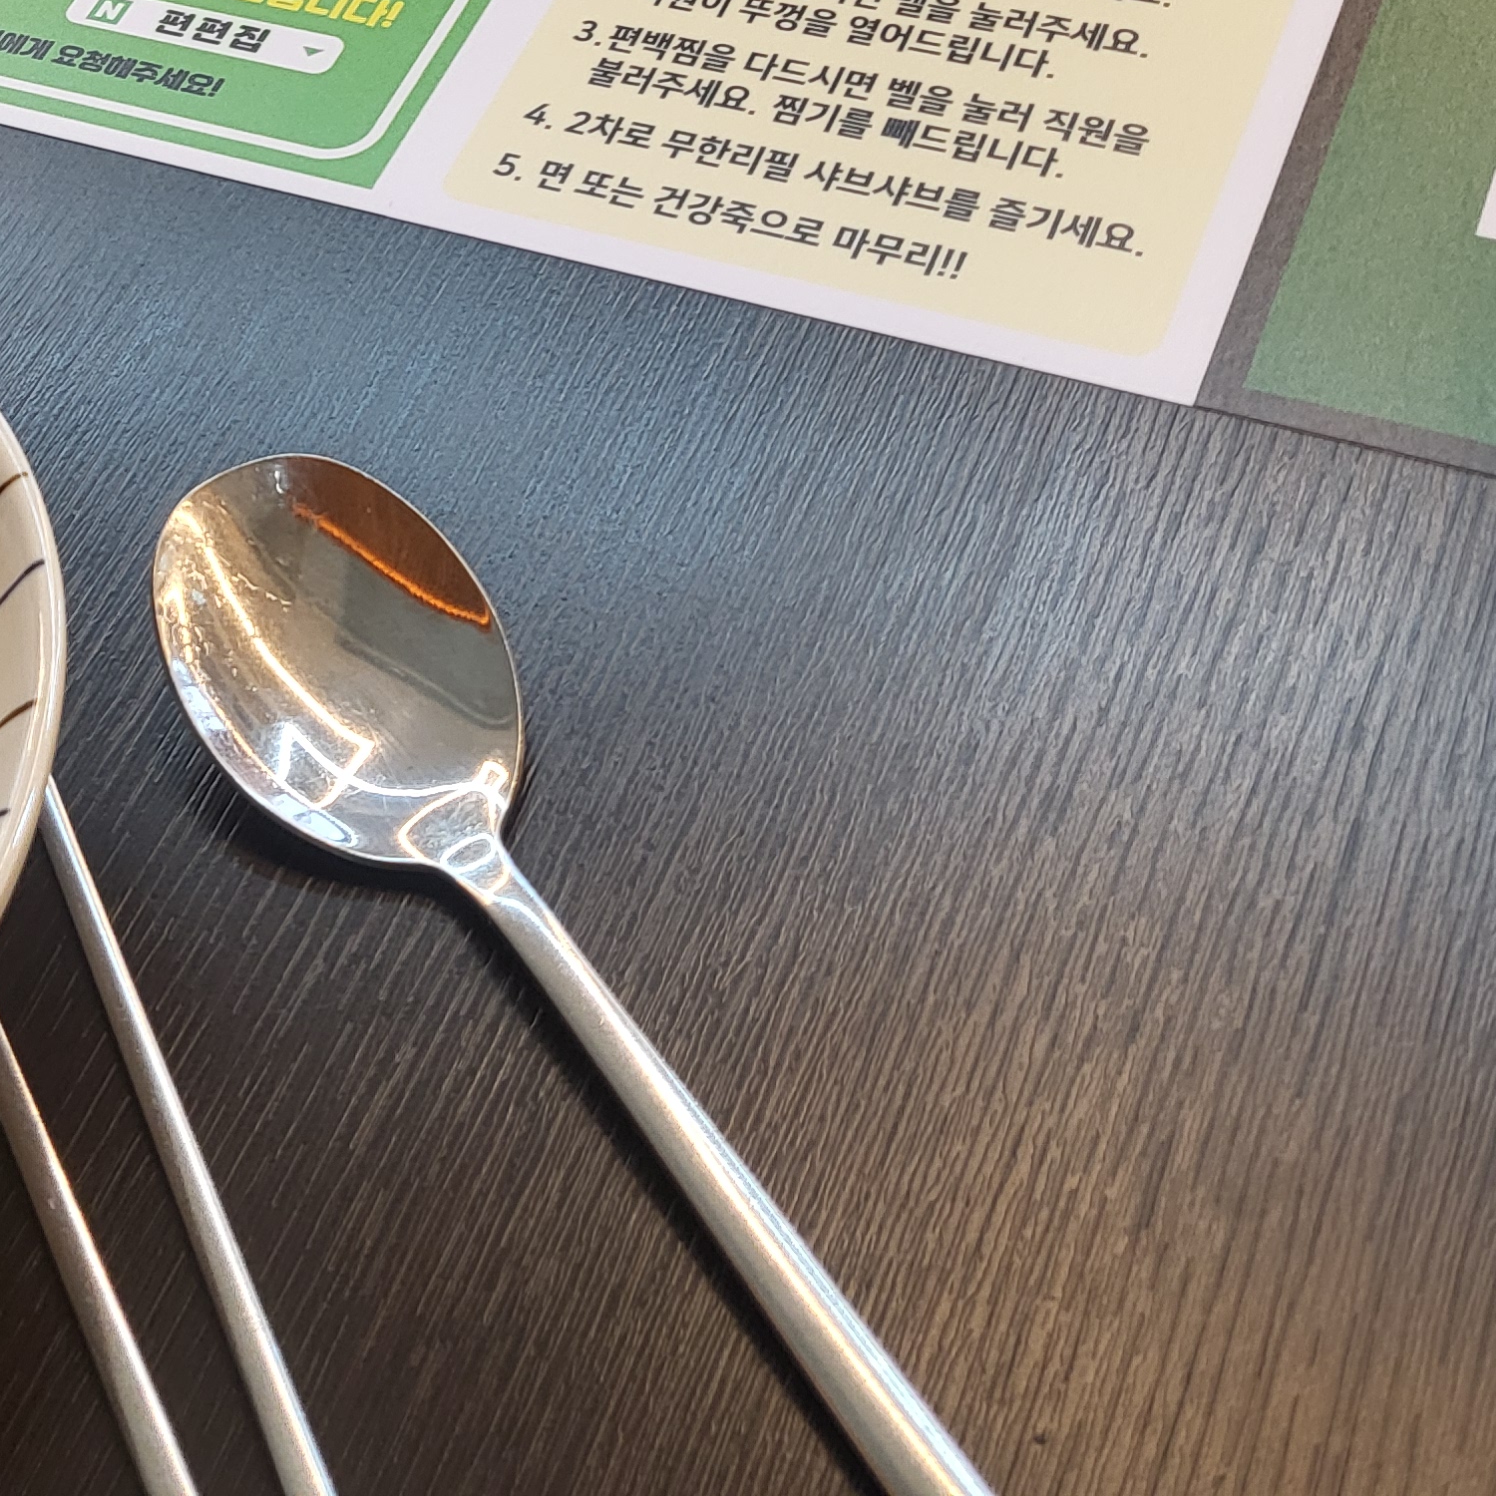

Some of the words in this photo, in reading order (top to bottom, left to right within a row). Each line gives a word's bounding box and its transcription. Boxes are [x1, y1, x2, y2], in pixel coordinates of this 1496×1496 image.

[51, 45, 225, 98] 요청해주세요!
[155, 8, 271, 54] 편편집
[846, 15, 1057, 80] 열어드립니다.
[969, 0, 1150, 59] 눌러주세요.
[588, 57, 758, 117] 불러주세요.
[772, 93, 876, 138] 찜기를
[881, 117, 1064, 179] 빼드립니다.
[605, 24, 739, 72] 편백찜을
[744, 47, 879, 101] 다드시면
[884, 75, 955, 114] 벨을
[962, 89, 1034, 128] 눌러
[1043, 107, 1152, 155] 직원을
[491, 153, 524, 182] 5.
[537, 160, 573, 193] 면
[574, 168, 645, 207] 또는
[651, 186, 823, 249] 건강죽으로
[832, 226, 969, 284] 마무리!!
[522, 103, 552, 131] 4.
[563, 110, 654, 149] 2차로
[660, 129, 799, 184] 무한리필
[804, 160, 983, 222] 샤브샤브를
[987, 195, 1147, 259] 즐기세요.
